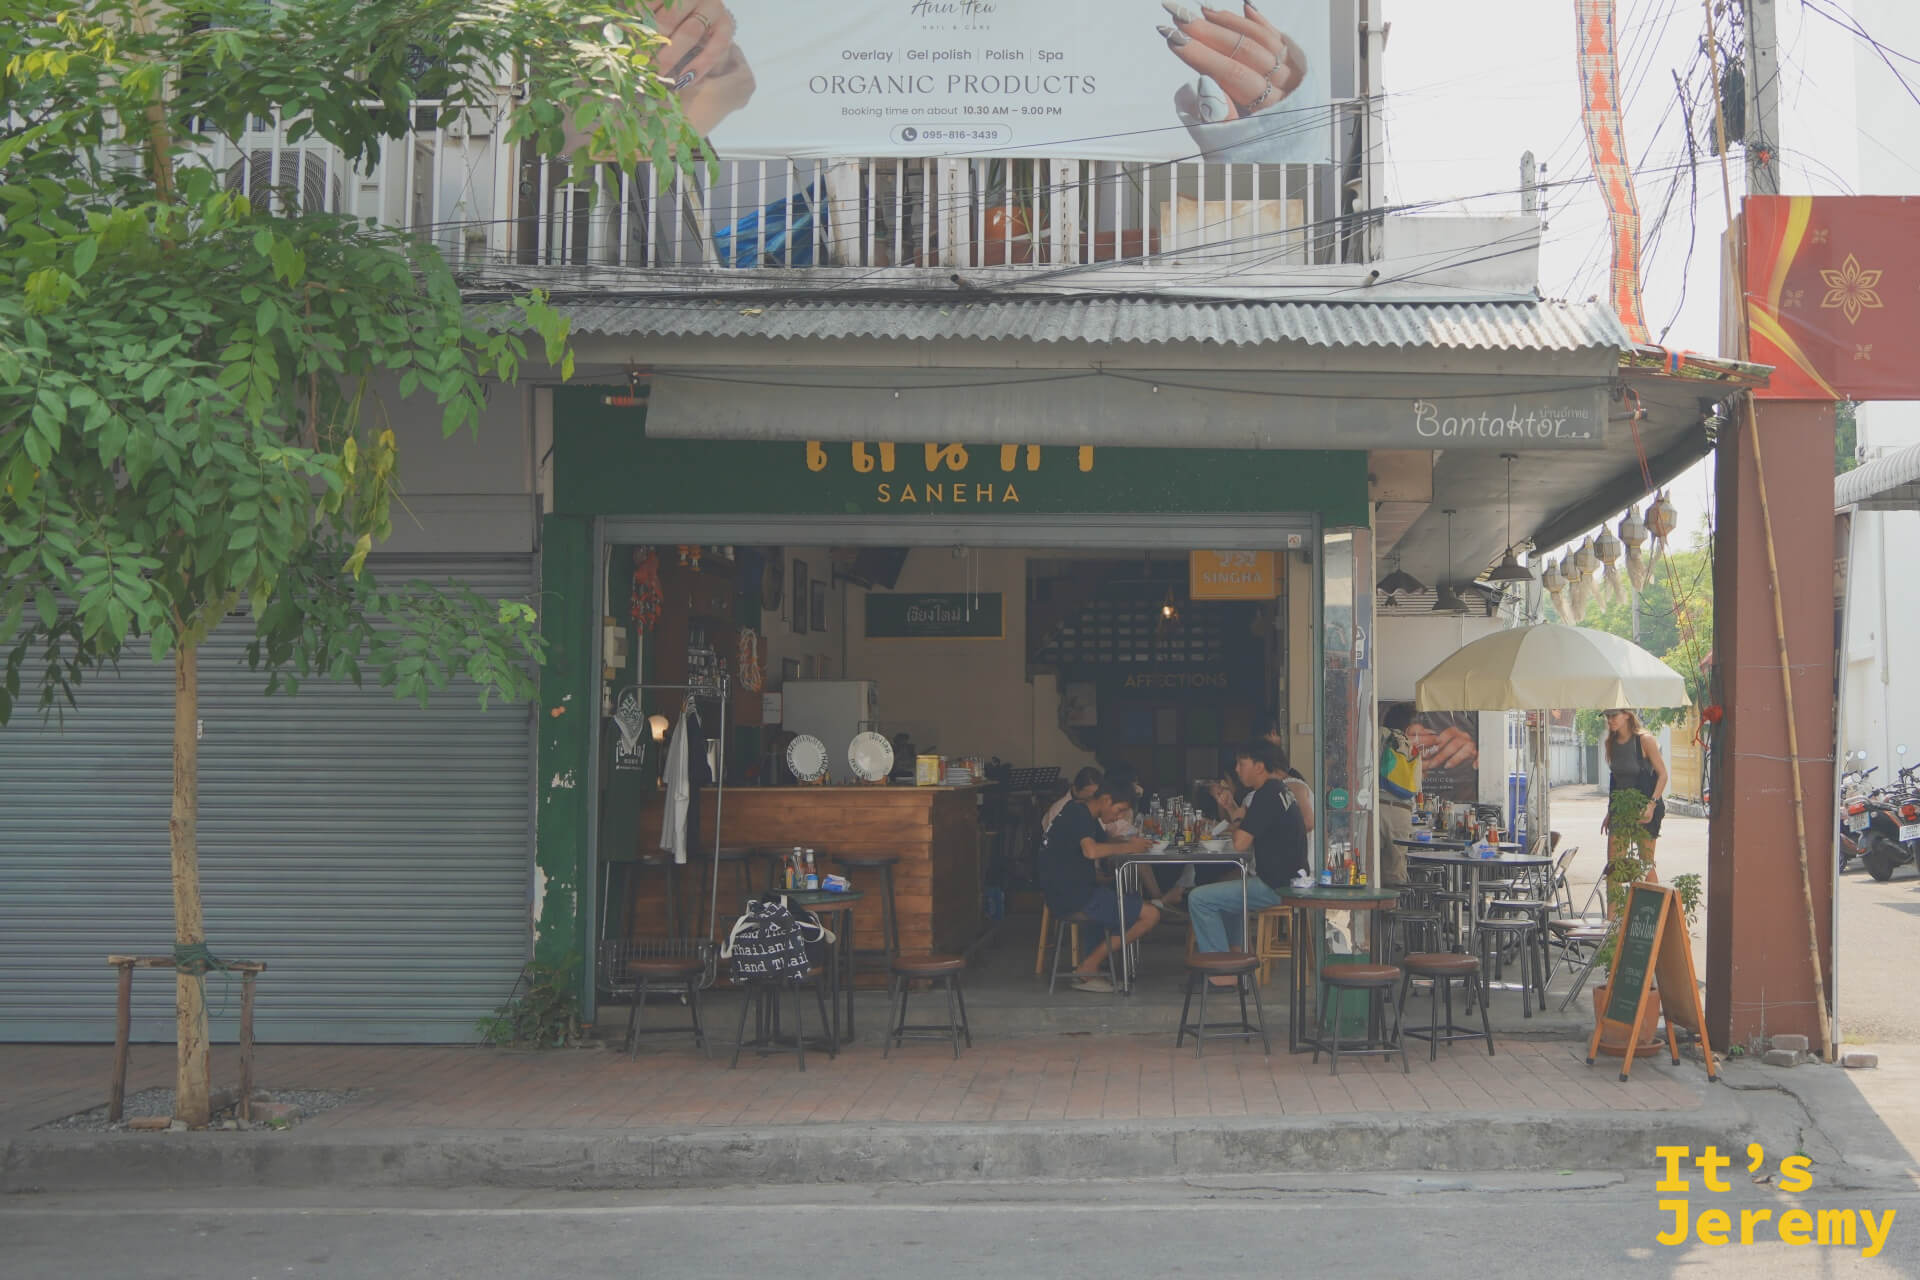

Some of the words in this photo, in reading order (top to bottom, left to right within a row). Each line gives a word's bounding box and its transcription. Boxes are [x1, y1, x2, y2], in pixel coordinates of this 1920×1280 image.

[841, 49, 894, 64] Overlay
[906, 49, 929, 61] Gel
[931, 48, 972, 64] polish
[985, 48, 1024, 61] Polish
[1037, 49, 1064, 64] Spa
[808, 74, 935, 95] ORGANIC
[947, 74, 1096, 95] PRODUCTS
[841, 106, 883, 118] Booking
[885, 106, 909, 116] time
[911, 107, 925, 116] on
[926, 106, 958, 116] about
[962, 106, 990, 116] 10.30
[991, 106, 1009, 116] AM
[1020, 105, 1044, 116] 9.00
[1046, 106, 1062, 116] PM
[922, 129, 998, 140] 095-816-3439
[877, 483, 1020, 503] SANEHA
[1203, 570, 1263, 584] SINGHA
